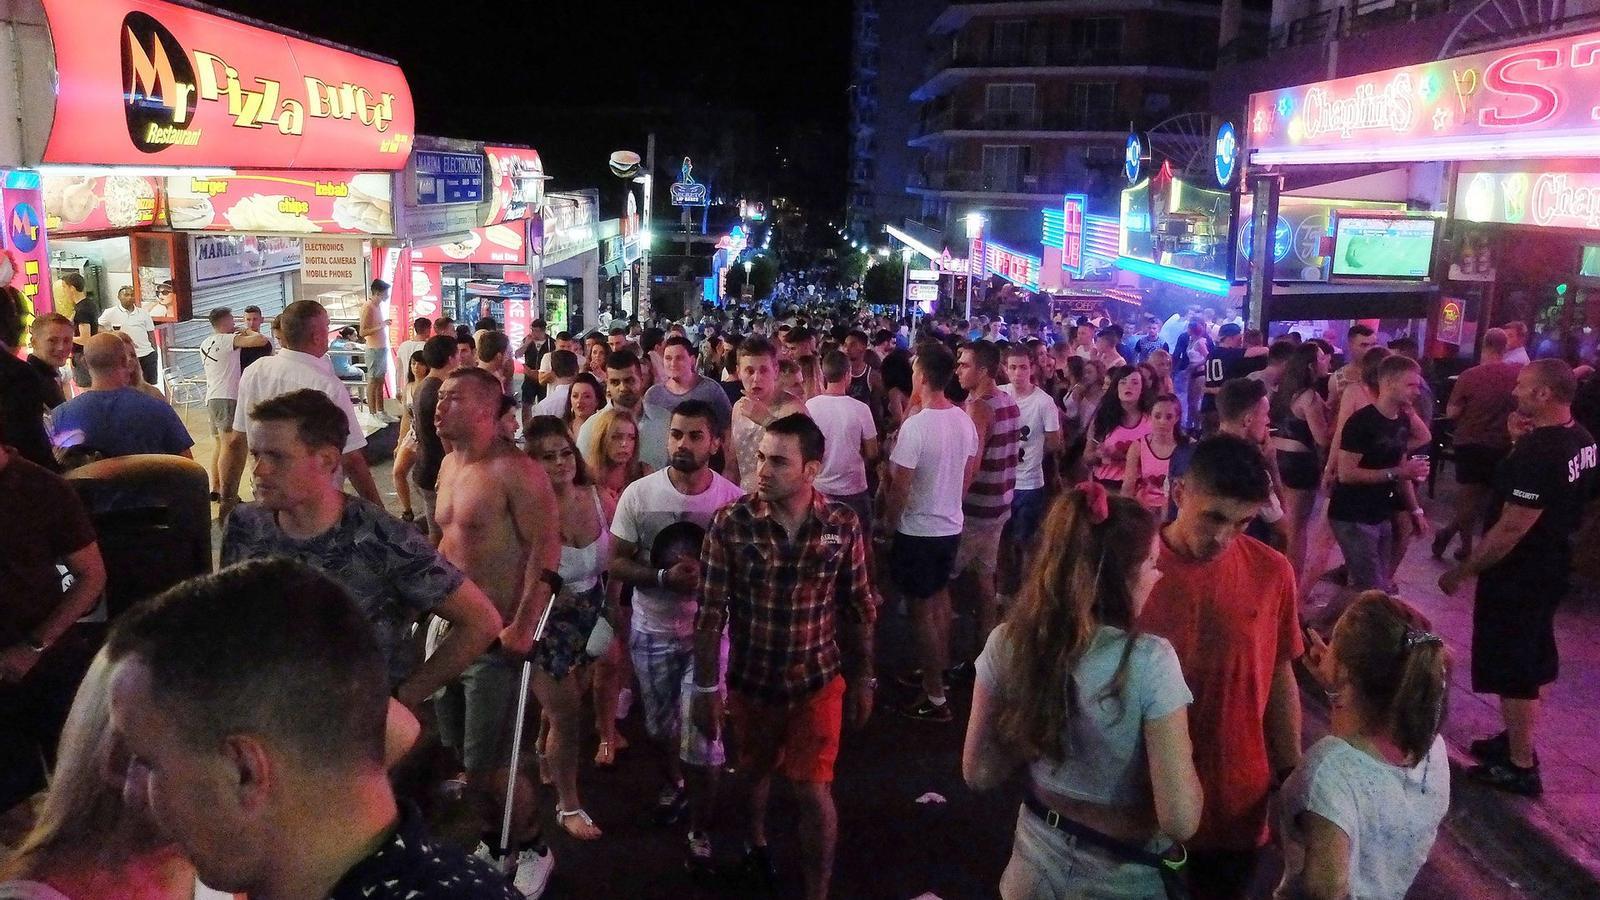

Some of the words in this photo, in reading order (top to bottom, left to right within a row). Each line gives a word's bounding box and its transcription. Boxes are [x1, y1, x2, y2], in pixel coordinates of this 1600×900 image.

[127, 25, 196, 123] Mr
[192, 48, 304, 135] Pizza
[146, 122, 201, 145] Restaurant
[443, 156, 481, 174] ELECTRONICS
[191, 177, 228, 195] burger
[315, 181, 348, 197] kebab
[278, 197, 309, 216] chips
[13, 208, 39, 241] Mr
[199, 240, 239, 261] MARIN
[304, 243, 345, 252] ELECTRONICS
[305, 256, 328, 265] DIGITAL
[328, 256, 357, 265] CAMERAS
[306, 269, 328, 278] MOBILE
[329, 269, 353, 279] PHONES
[1206, 358, 1224, 382] 10
[1513, 488, 1540, 501] SECURITY
